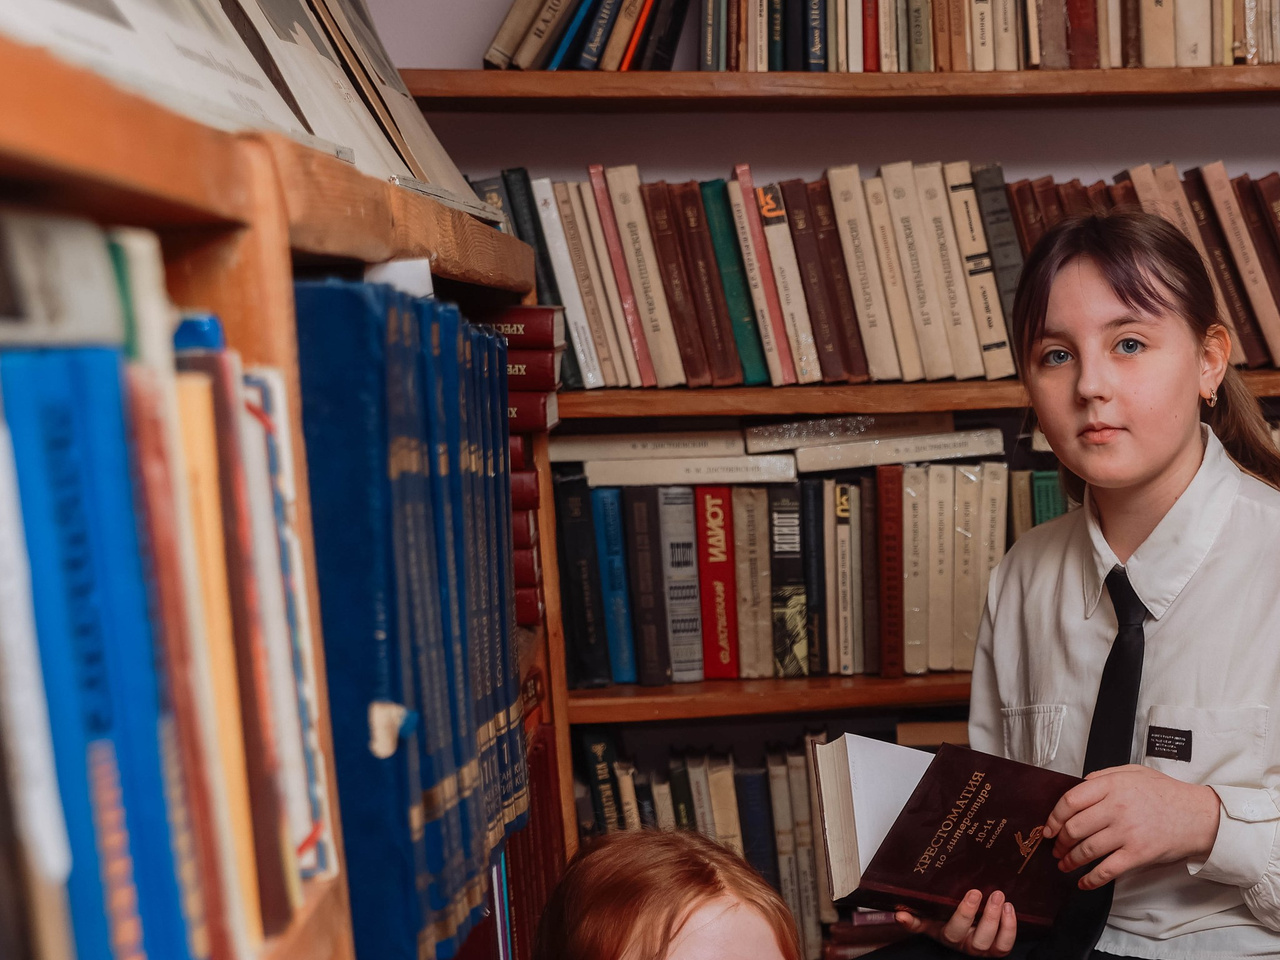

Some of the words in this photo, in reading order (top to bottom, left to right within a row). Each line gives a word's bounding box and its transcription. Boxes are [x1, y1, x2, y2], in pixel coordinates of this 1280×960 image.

[914, 7, 922, 44] ПОЭМА
[733, 201, 755, 274] ЧЕРНЫШЕВСКИЙ
[847, 216, 874, 311] ЧЕРНЫШЕВСКИЙ
[900, 214, 928, 308] ЧЕРНЫШЕВСКИЙ
[932, 214, 959, 309] ЧЕРНЫШЕВСКИЙ
[626, 219, 657, 315] ЧЕРНЫШЕВСКИЙ
[807, 260, 832, 341] ЧЕРНЫШЕВСКИЙ
[980, 284, 991, 315] ДЕЛАТЬ?
[985, 315, 994, 329] ЧТО
[651, 440, 709, 449] ДОСТОЕВСКИЙ
[699, 493, 732, 564] ИДИОТ
[771, 510, 800, 552] ИДИОТ
[908, 500, 921, 556] ДОСТОЕВСКИЙ
[936, 499, 946, 554] ДОСТОЕВСКИЙ
[986, 496, 997, 551] ДОСТОЕВСКИЙ
[913, 770, 986, 875] ХРЕСТОМАТИЯ
[934, 853, 947, 870] по
[947, 782, 992, 853] литературе
[966, 821, 980, 836] для
[975, 818, 996, 844] 10-11
[984, 818, 1008, 850] классов
